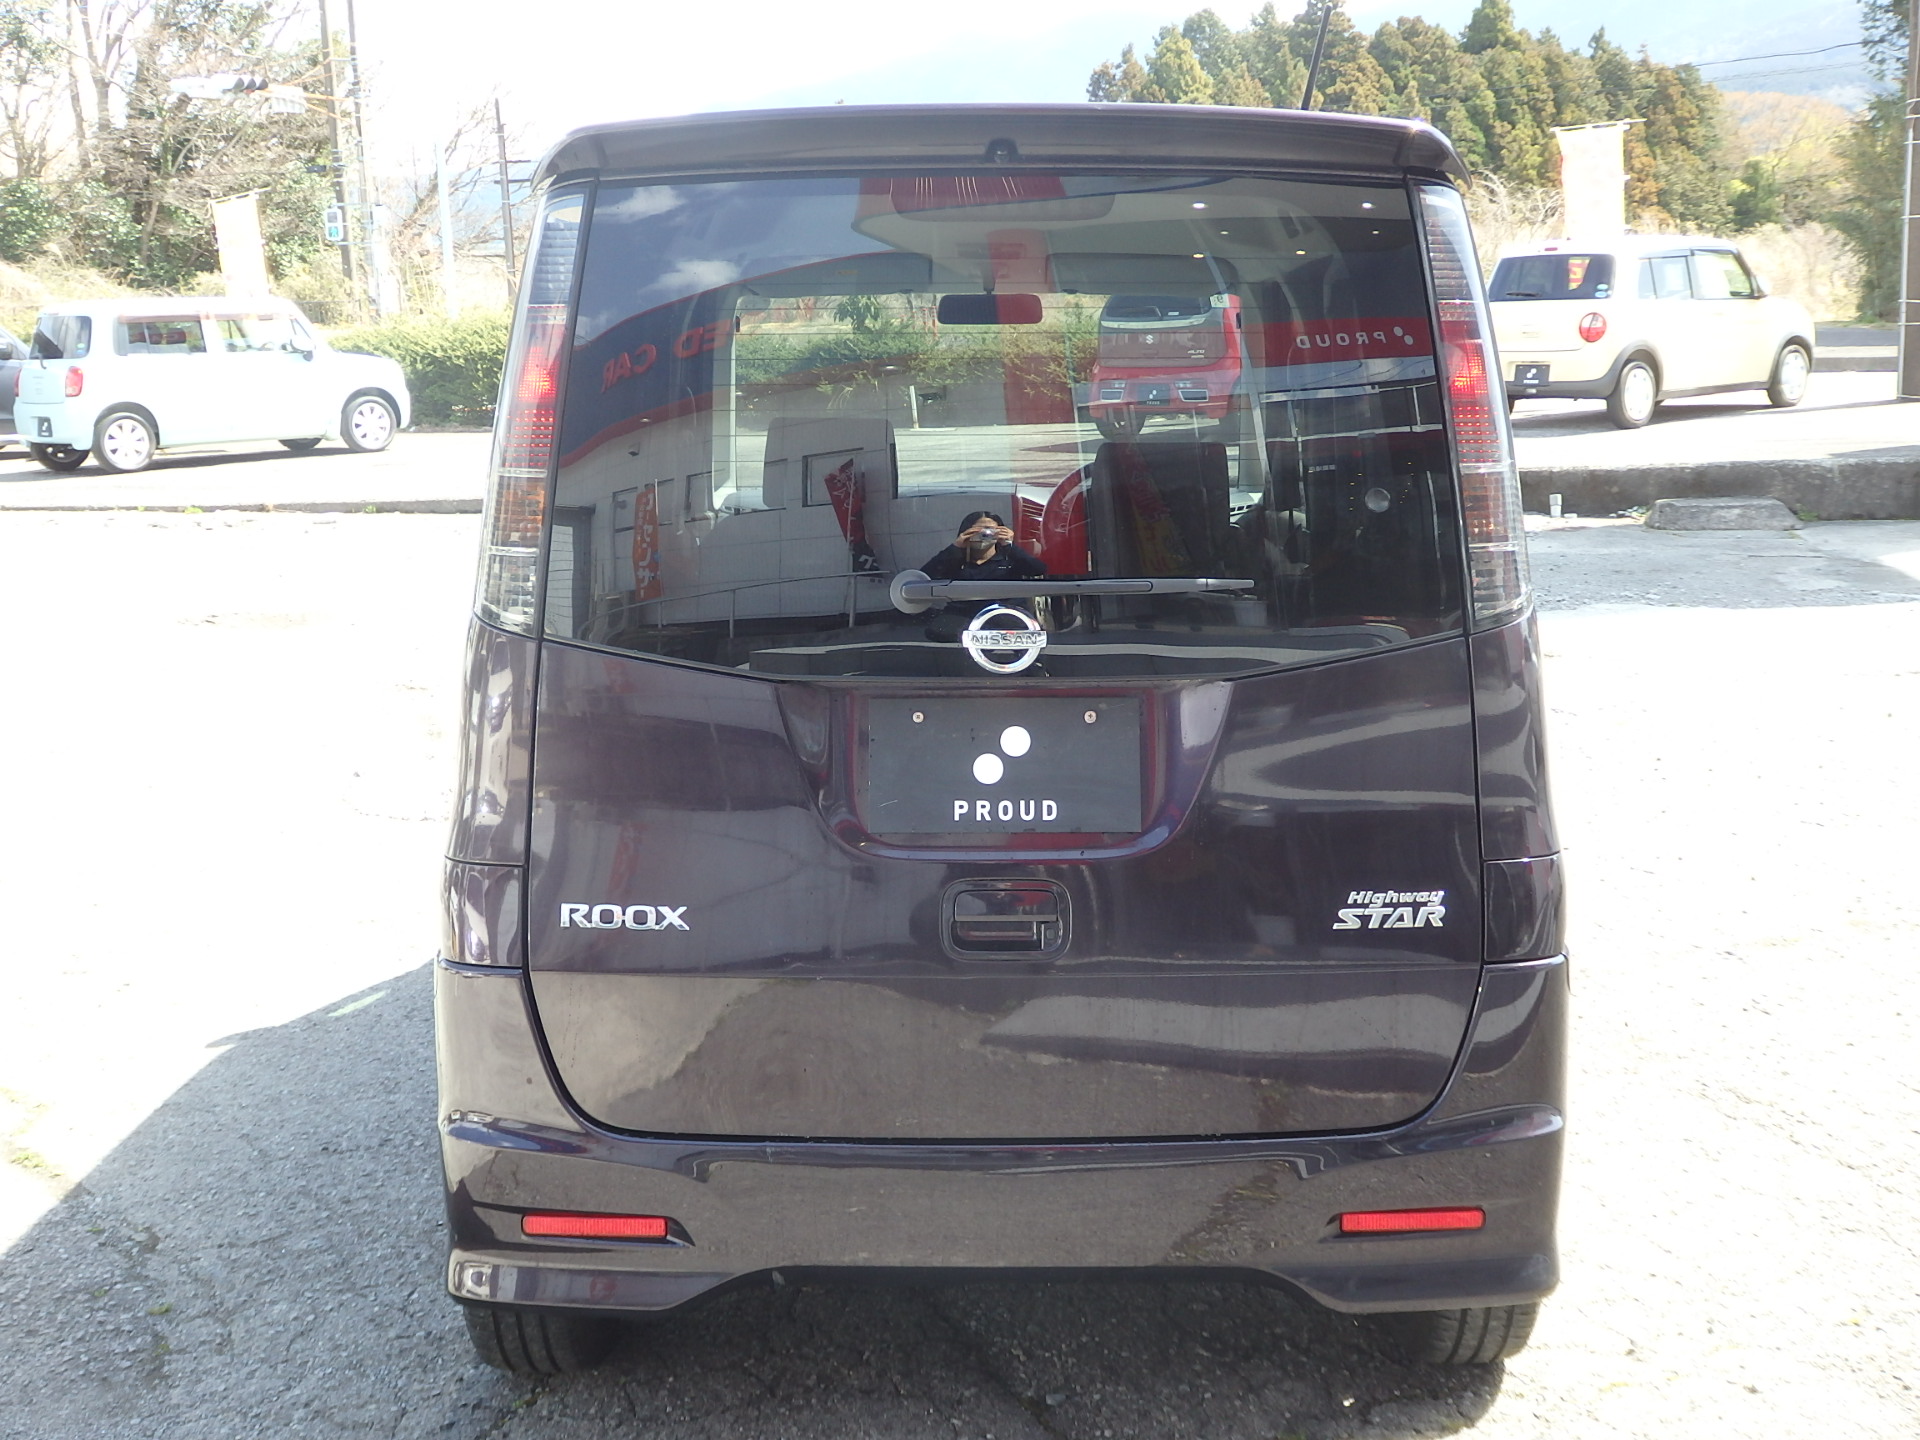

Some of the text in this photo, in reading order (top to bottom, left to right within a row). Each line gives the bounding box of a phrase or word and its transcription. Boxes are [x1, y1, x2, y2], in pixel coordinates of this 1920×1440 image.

[972, 634, 1038, 645] NISSAN
[953, 800, 1059, 821] PROUD
[1347, 890, 1445, 908] Highway
[560, 902, 691, 931] ROOX
[1332, 905, 1446, 930] STAR
